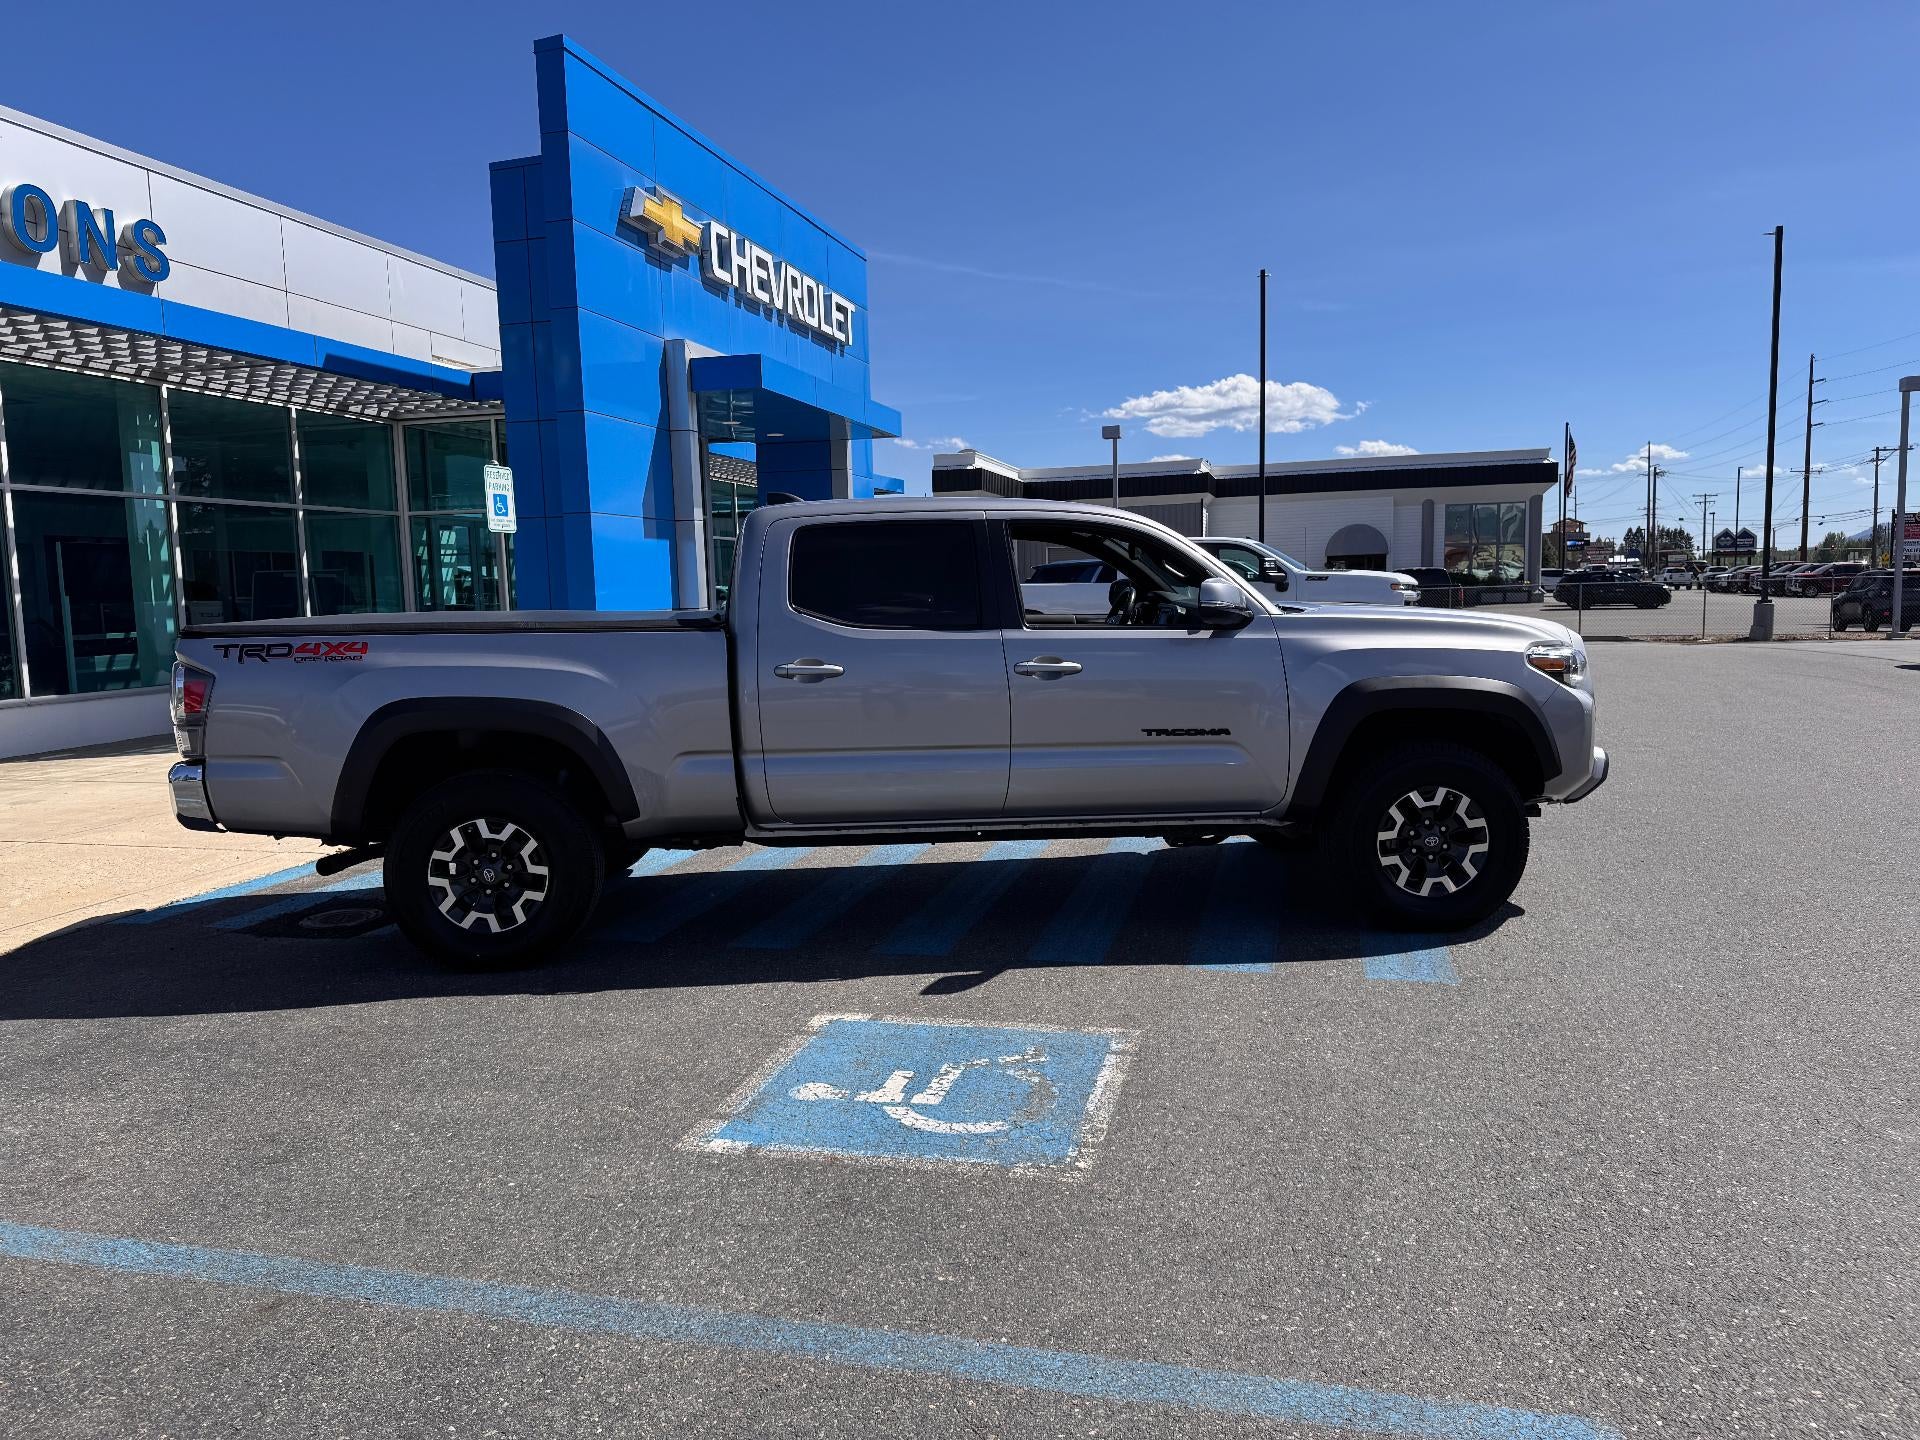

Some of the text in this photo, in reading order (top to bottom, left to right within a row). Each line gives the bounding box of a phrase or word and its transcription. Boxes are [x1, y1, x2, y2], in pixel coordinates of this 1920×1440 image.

[1, 183, 171, 282] ONS
[708, 221, 856, 347] CHEVROLET
[488, 481, 511, 493] PARKING
[213, 642, 369, 664] TRD 4X4
[324, 655, 363, 663] ROAD
[1141, 728, 1232, 736] TACOMA
